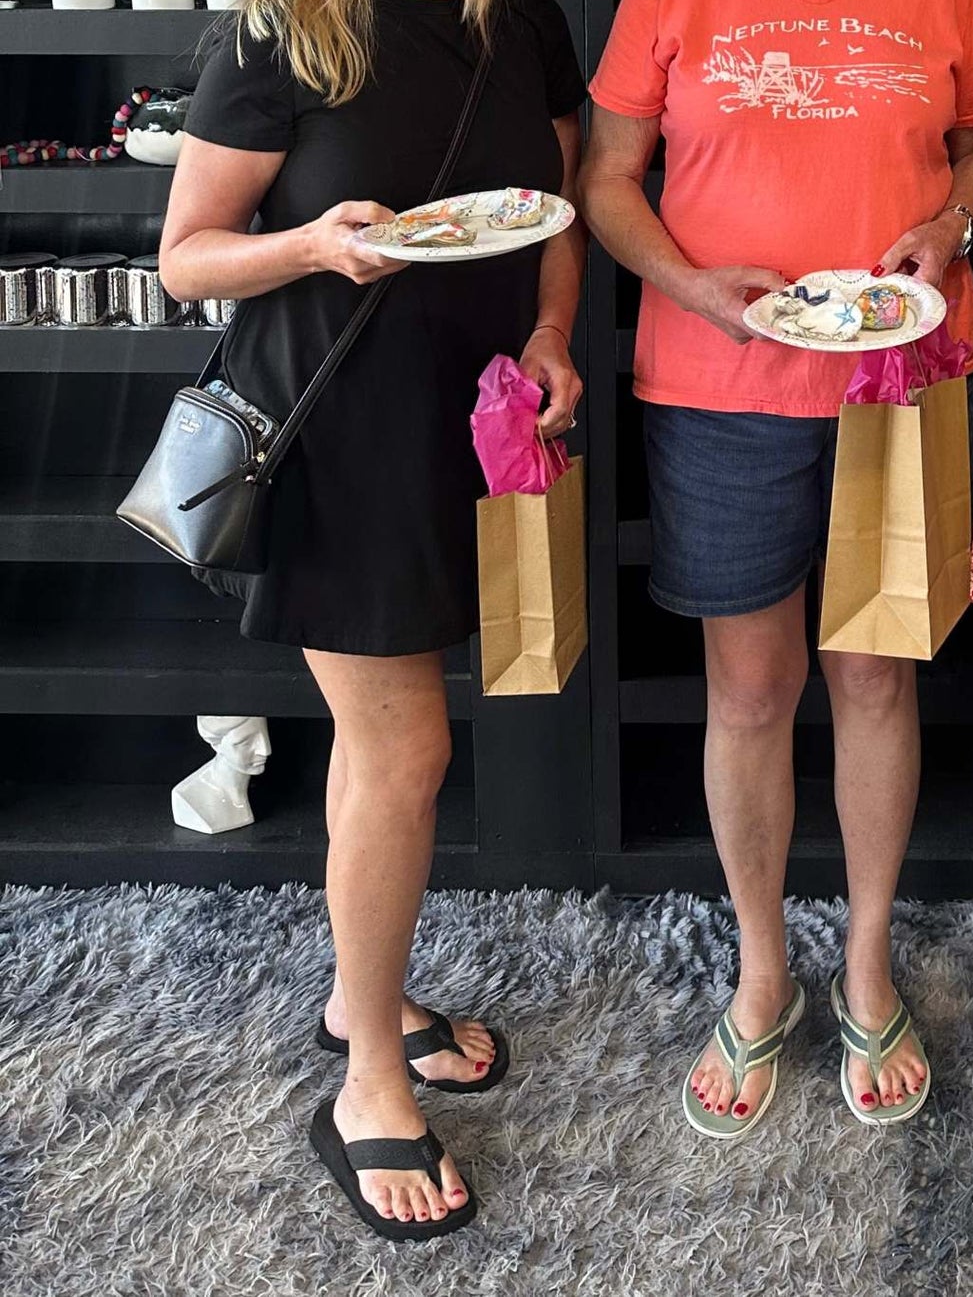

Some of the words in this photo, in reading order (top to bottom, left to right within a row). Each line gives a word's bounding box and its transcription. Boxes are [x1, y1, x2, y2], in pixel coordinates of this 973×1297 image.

[712, 18, 830, 50] NEPTUNE
[840, 17, 923, 51] BEACH
[771, 105, 859, 119] FLORIDA
